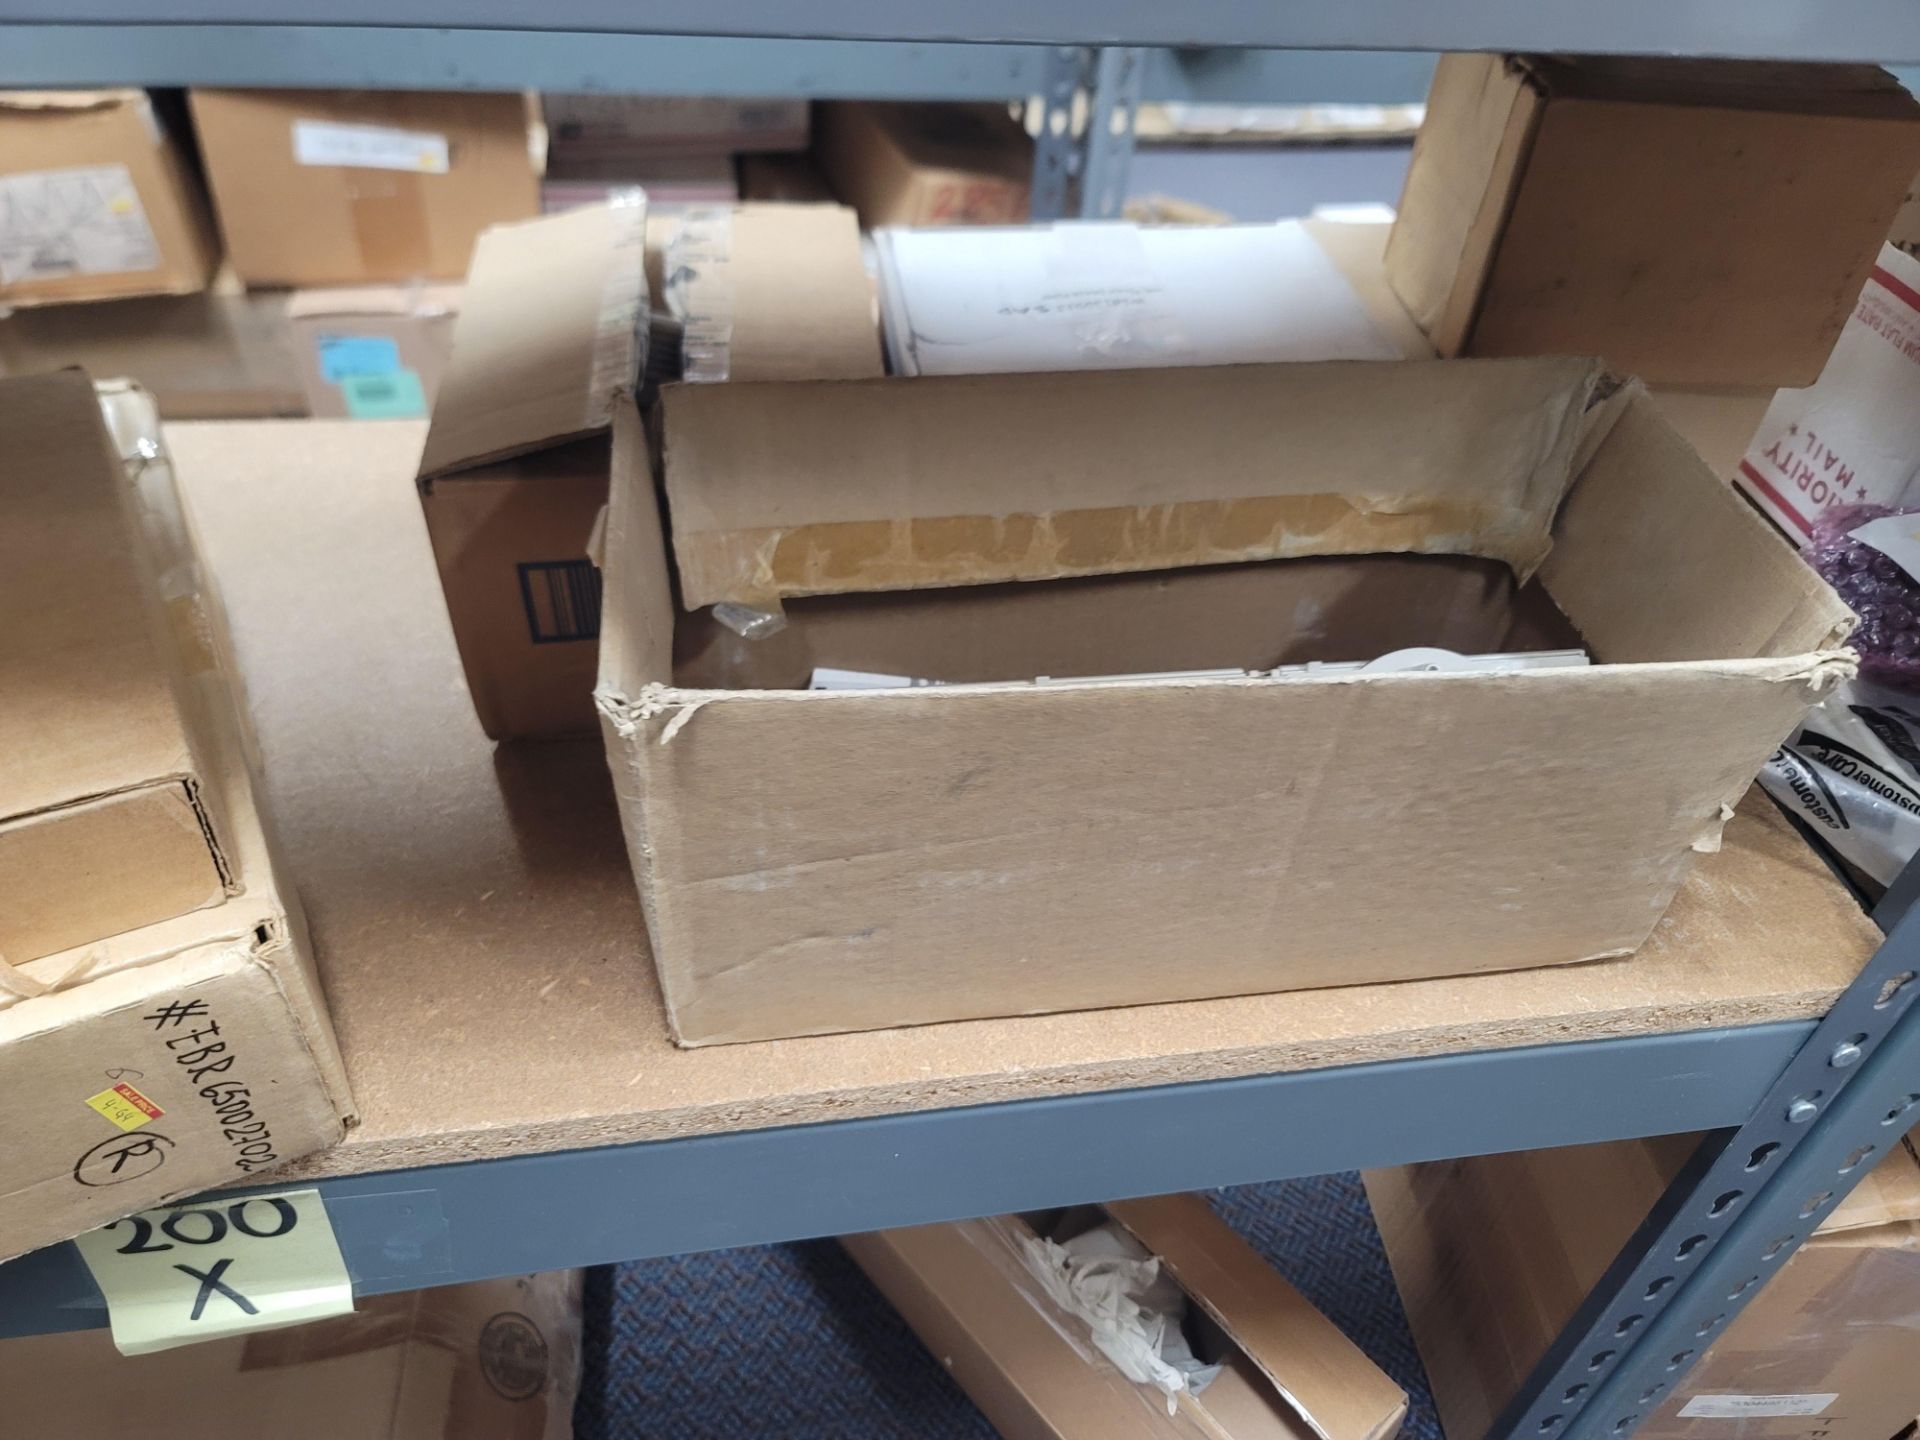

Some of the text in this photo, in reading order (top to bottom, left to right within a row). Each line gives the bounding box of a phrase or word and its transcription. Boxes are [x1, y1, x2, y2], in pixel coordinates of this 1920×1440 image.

[1762, 441, 1843, 508] IORITY
[1806, 431, 1855, 489] MAIL
[103, 1197, 298, 1254] 200
[172, 1258, 260, 1321] X
